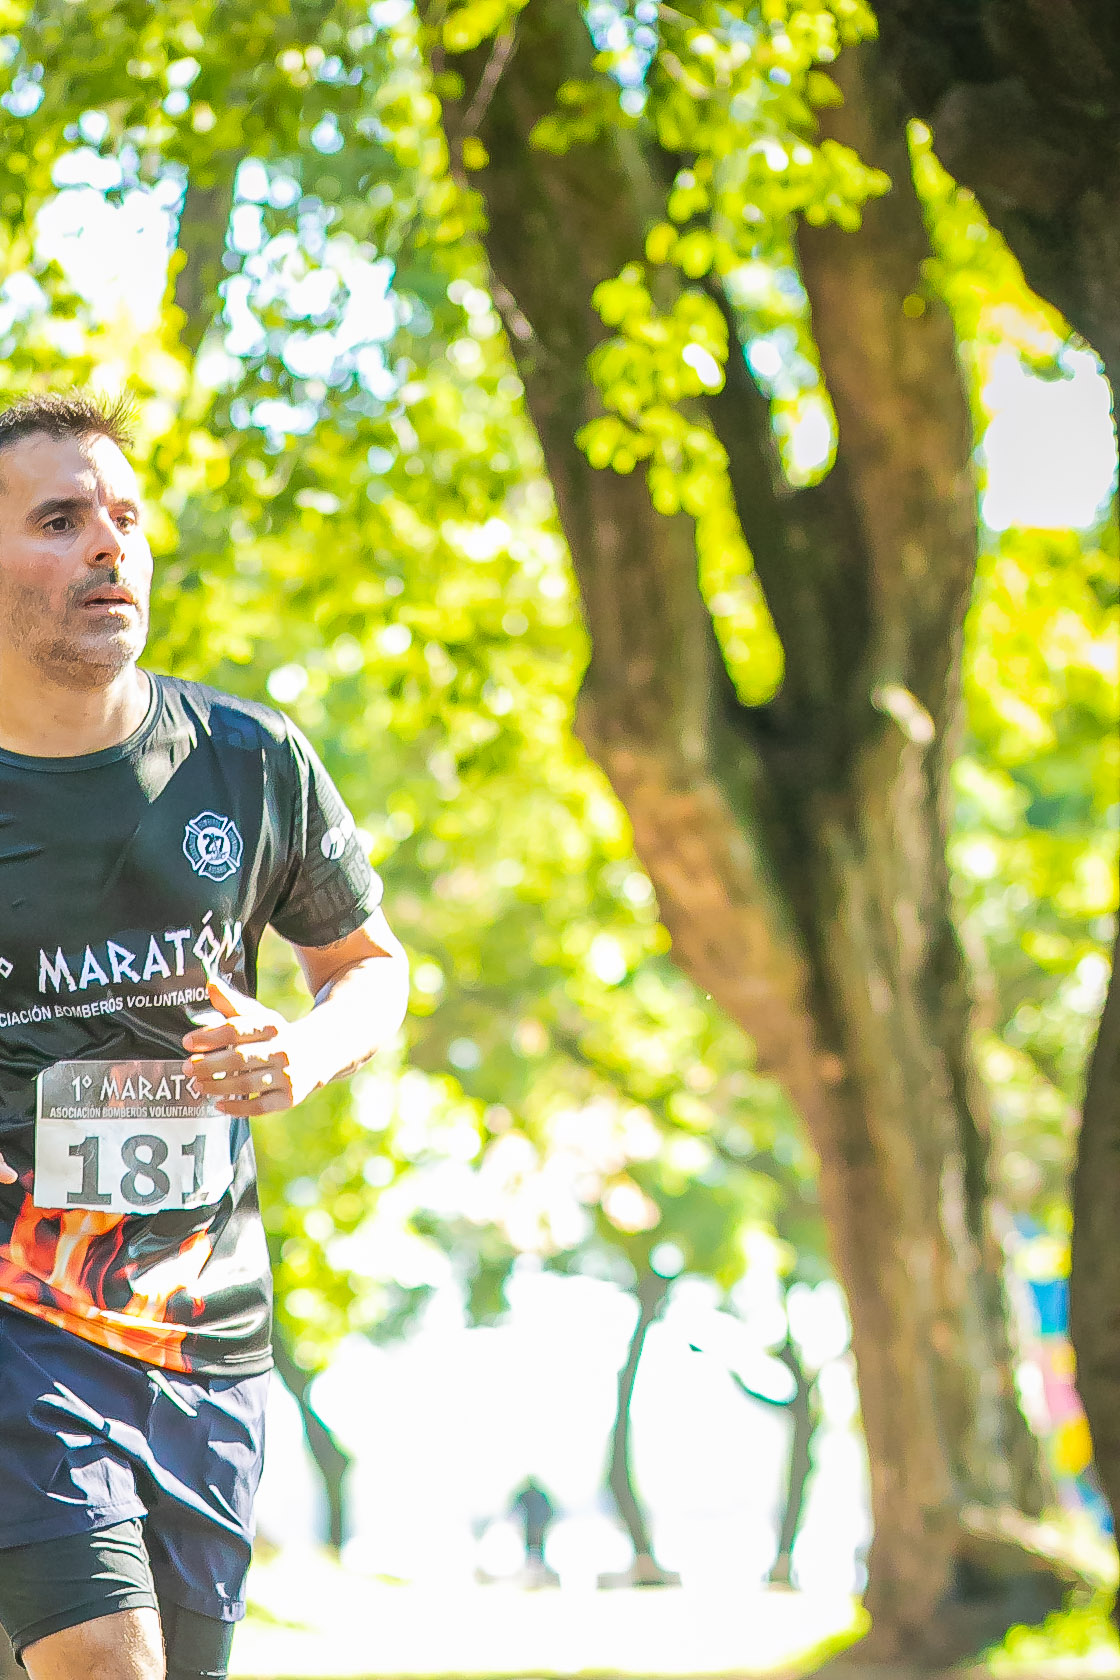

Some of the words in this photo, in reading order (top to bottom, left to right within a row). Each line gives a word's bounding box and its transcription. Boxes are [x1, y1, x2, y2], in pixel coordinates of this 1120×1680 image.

[38, 909, 242, 994] MARATÓN
[54, 997, 124, 1019] BOMBEROS
[99, 1073, 202, 1102] MARAT
[49, 1104, 101, 1119] ASOCIACIÓN
[102, 1105, 148, 1119] BOMBEROS
[149, 1104, 205, 1118] VOLUNTARIOS
[66, 1134, 208, 1206] 181
